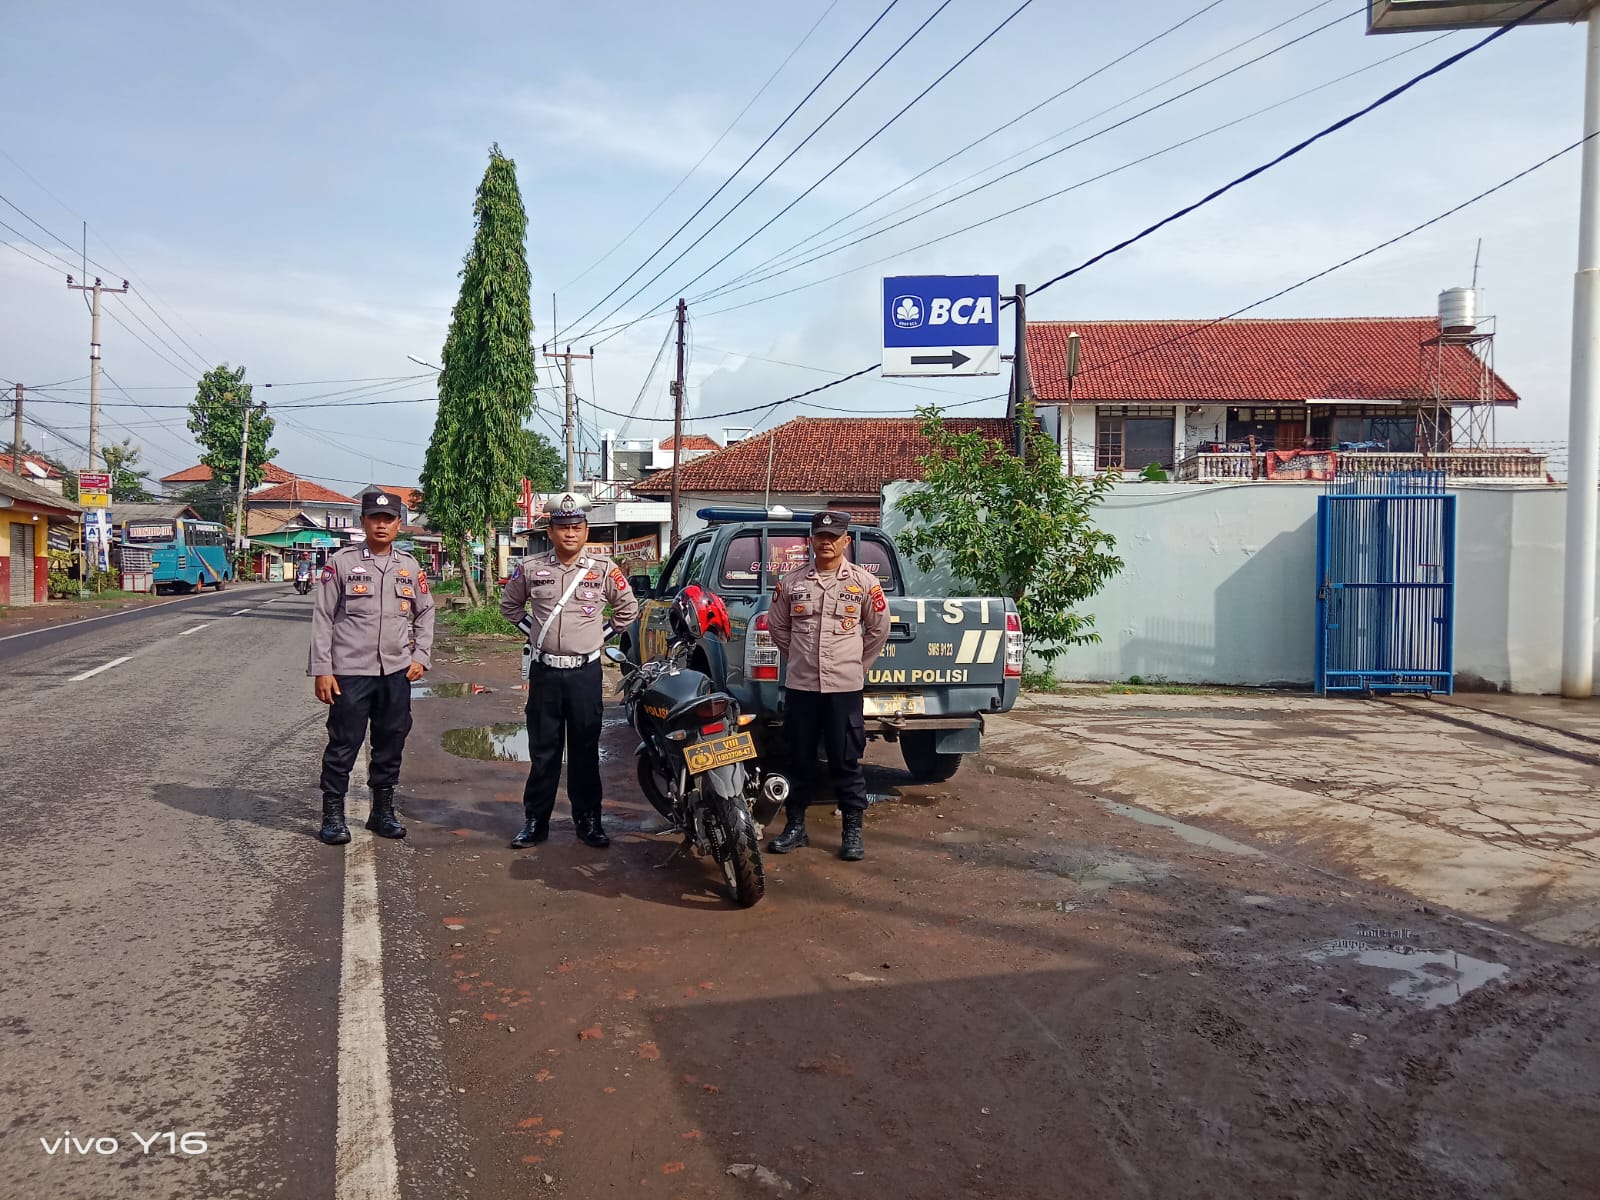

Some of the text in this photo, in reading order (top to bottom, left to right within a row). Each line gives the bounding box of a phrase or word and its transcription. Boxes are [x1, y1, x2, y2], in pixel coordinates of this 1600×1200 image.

[929, 297, 993, 325] BCA
[839, 593, 862, 601] POLRI
[927, 642, 953, 657] SMS 9123
[866, 669, 968, 683] UAN POLISI
[643, 704, 669, 720] POLISI
[723, 738, 739, 749] VIII
